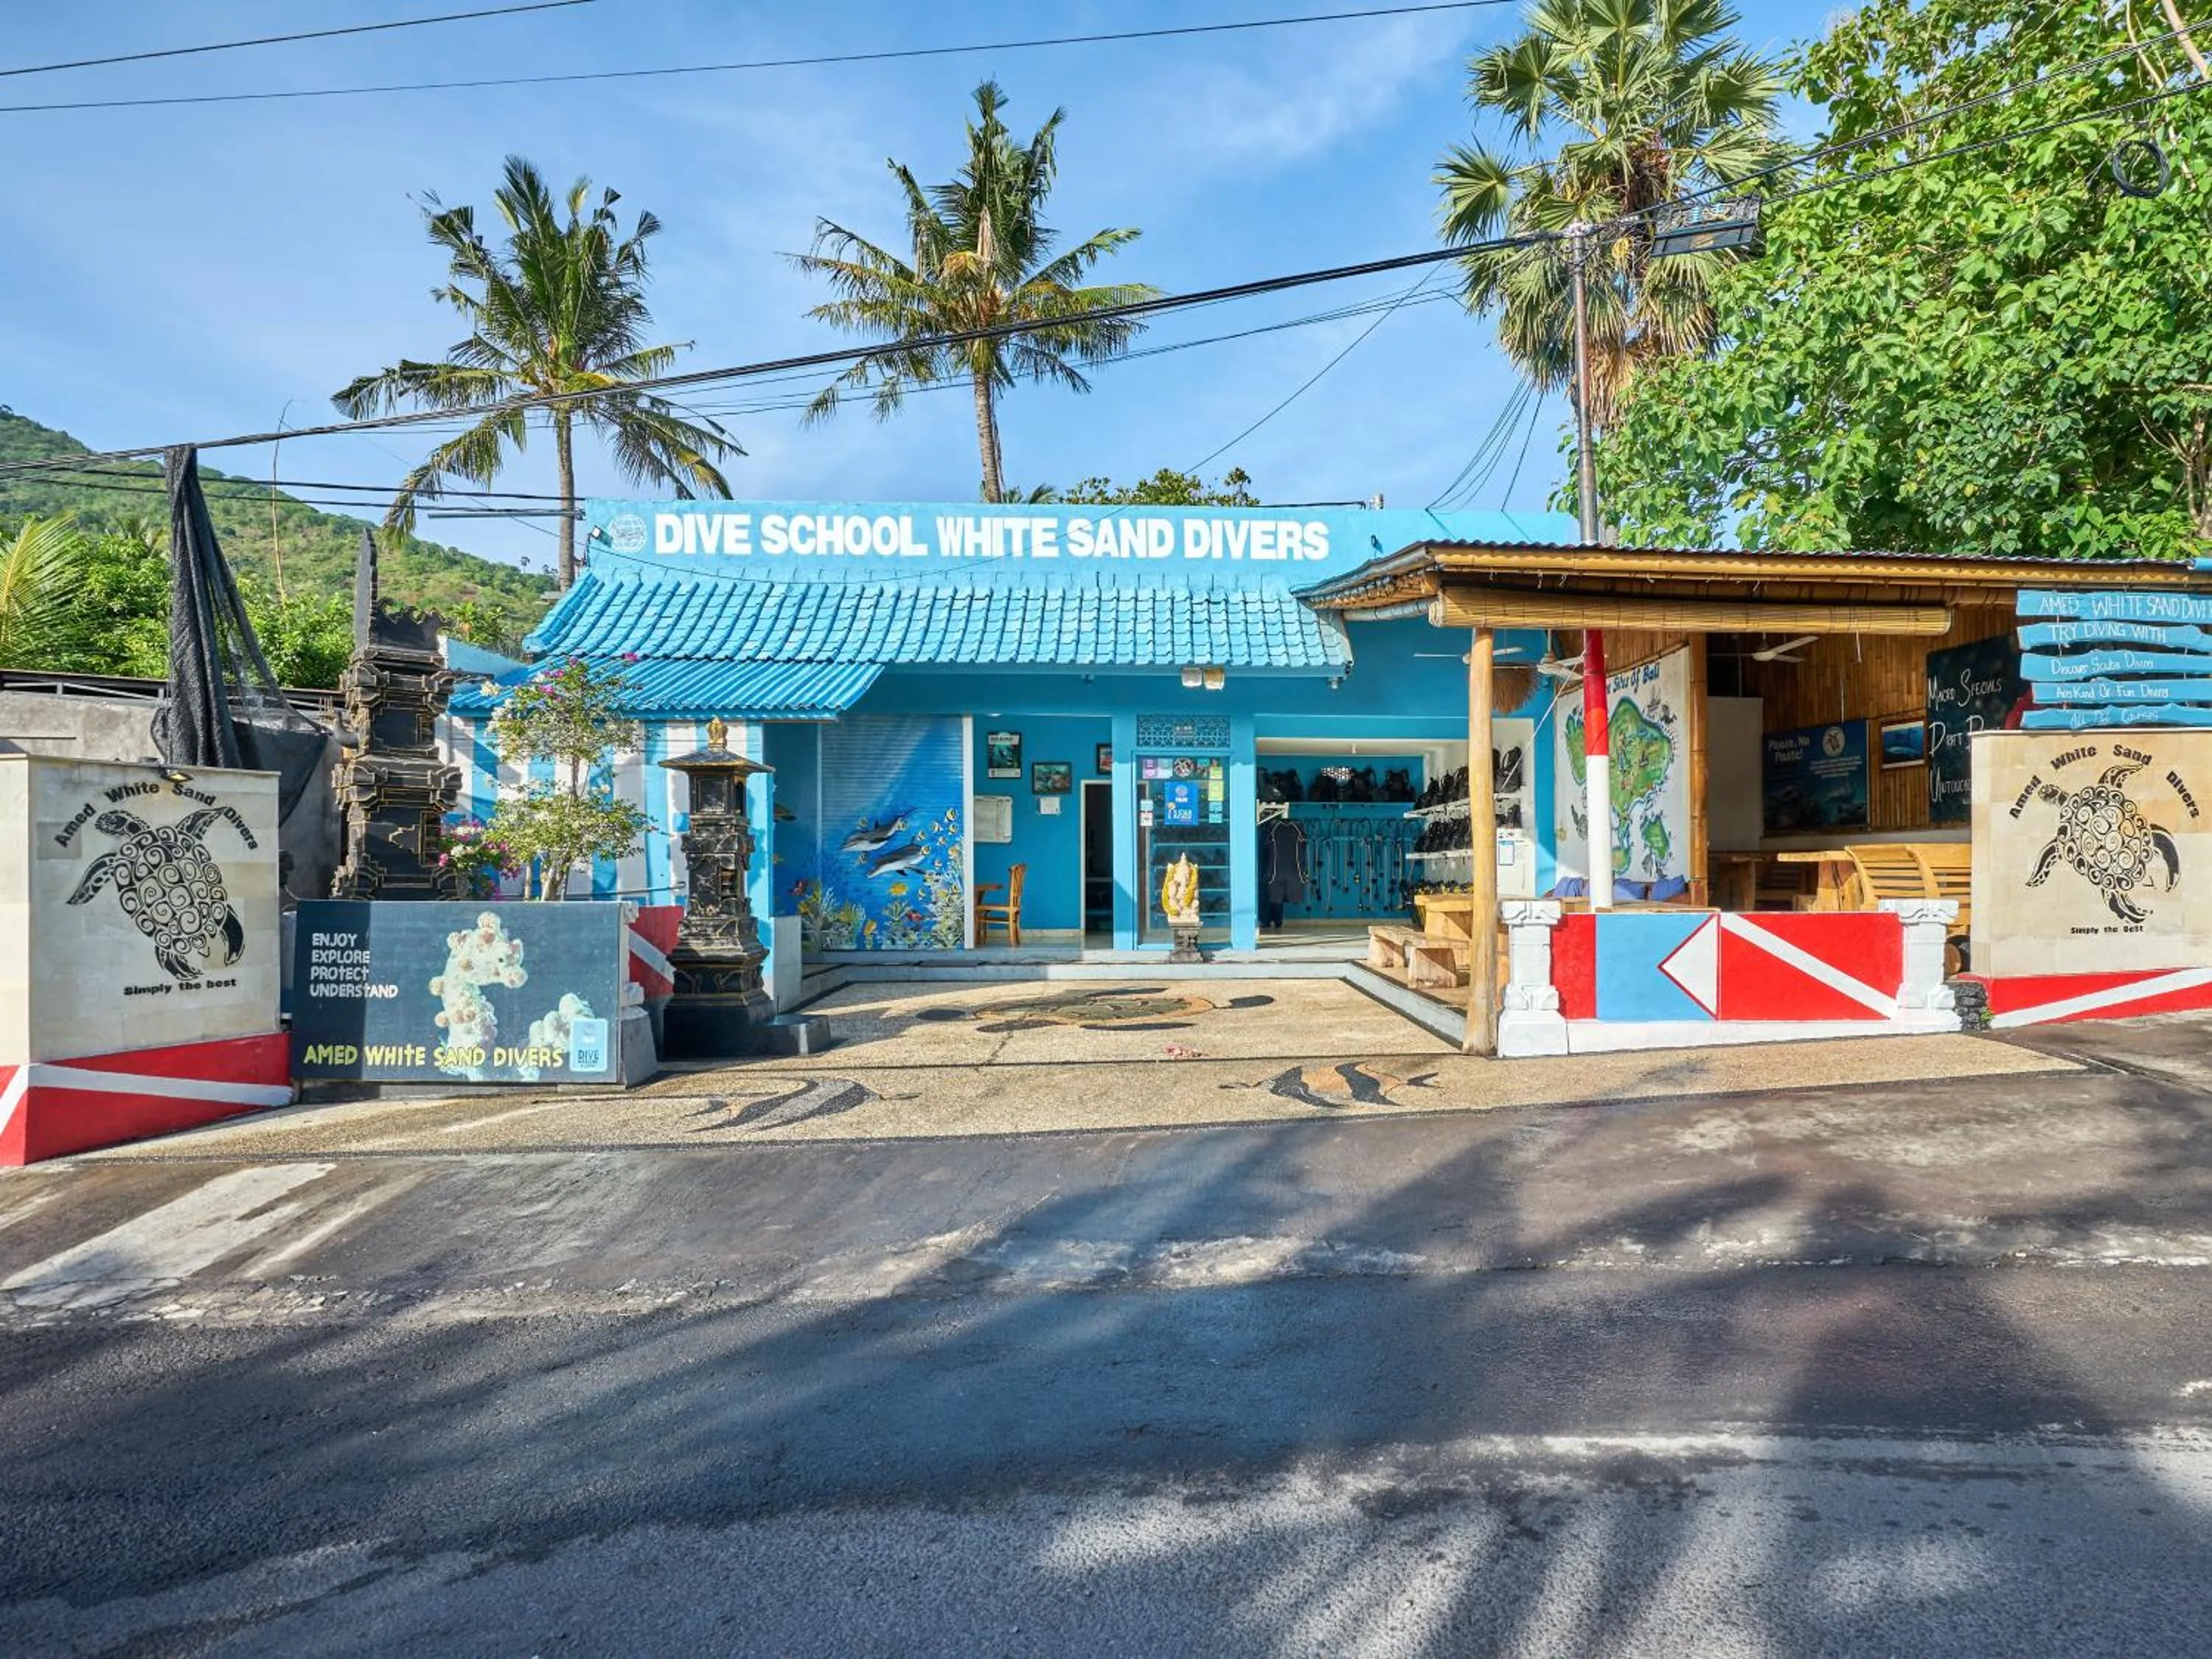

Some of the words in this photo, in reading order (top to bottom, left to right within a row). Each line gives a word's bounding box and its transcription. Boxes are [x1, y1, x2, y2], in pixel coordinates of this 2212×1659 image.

[655, 514, 751, 555] DIVE
[760, 515, 928, 556] SCHOOL
[936, 517, 1060, 558] WHITE
[1067, 518, 1175, 559] SAND
[1183, 519, 1329, 560] DIVERS
[2039, 596, 2079, 614] AMED
[2092, 594, 2143, 617] WHITE
[2146, 595, 2180, 617] SAND
[2048, 625, 2078, 641] TRY
[2132, 625, 2166, 644] WITH
[1643, 663, 1660, 684] Bali
[2009, 775, 2042, 820] Amed
[2050, 745, 2098, 771] White
[2112, 744, 2152, 765] Sand
[2166, 770, 2199, 818] Divers
[54, 802, 97, 849] Amed
[104, 781, 160, 803] White
[171, 782, 216, 806] Sand
[223, 806, 257, 850] Divers
[2070, 927, 2099, 935] Simply
[312, 933, 357, 947] ENJOY
[311, 950, 371, 964] EXPLORE
[310, 965, 369, 981] PROTECT
[123, 982, 173, 995] Simply
[178, 981, 201, 991] the
[310, 983, 399, 998] UNDERSTAND
[304, 1045, 358, 1065] AMED
[364, 1044, 425, 1067] WHITE
[434, 1046, 486, 1067] SAND
[493, 1047, 564, 1068] DIVERS
[578, 1050, 599, 1060] DIVE
